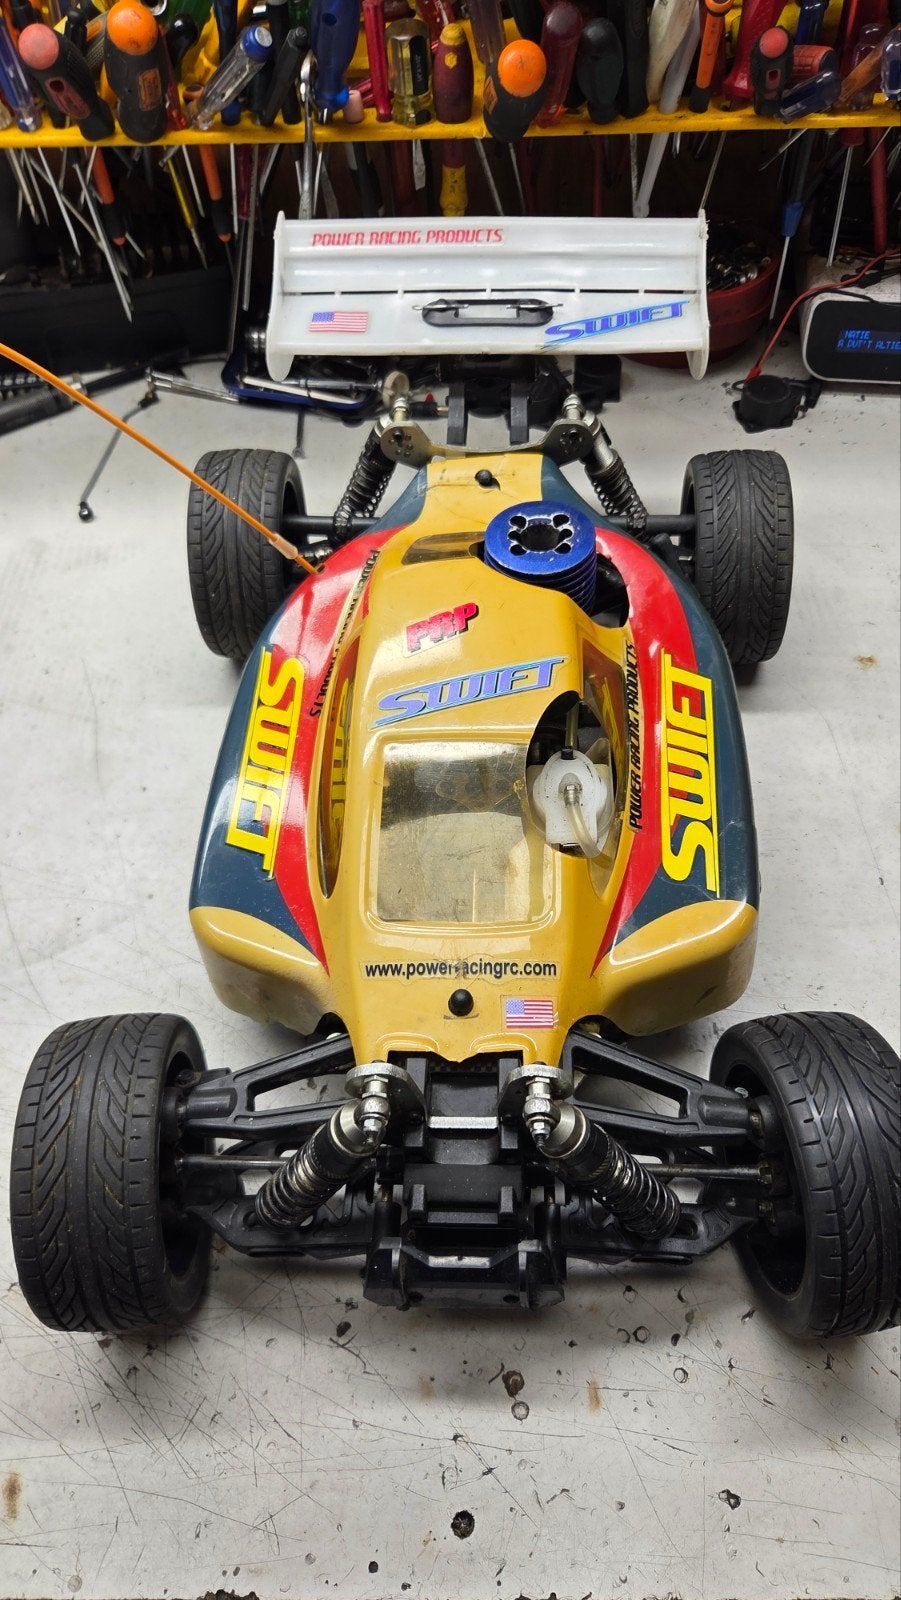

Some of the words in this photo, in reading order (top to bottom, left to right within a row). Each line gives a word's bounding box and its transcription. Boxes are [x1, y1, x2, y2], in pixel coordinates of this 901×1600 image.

[312, 231, 365, 246] POWER
[369, 230, 422, 245] RACING
[426, 229, 504, 244] PRODUCTS
[541, 299, 690, 349] SWIFT
[406, 602, 479, 653] PRP
[371, 656, 566, 730] SWIFT
[626, 639, 639, 715] PRODUCTS
[226, 646, 304, 880] SWIFT
[628, 717, 641, 771] RACING
[661, 648, 720, 899] SWIFT
[629, 769, 643, 830] POWER
